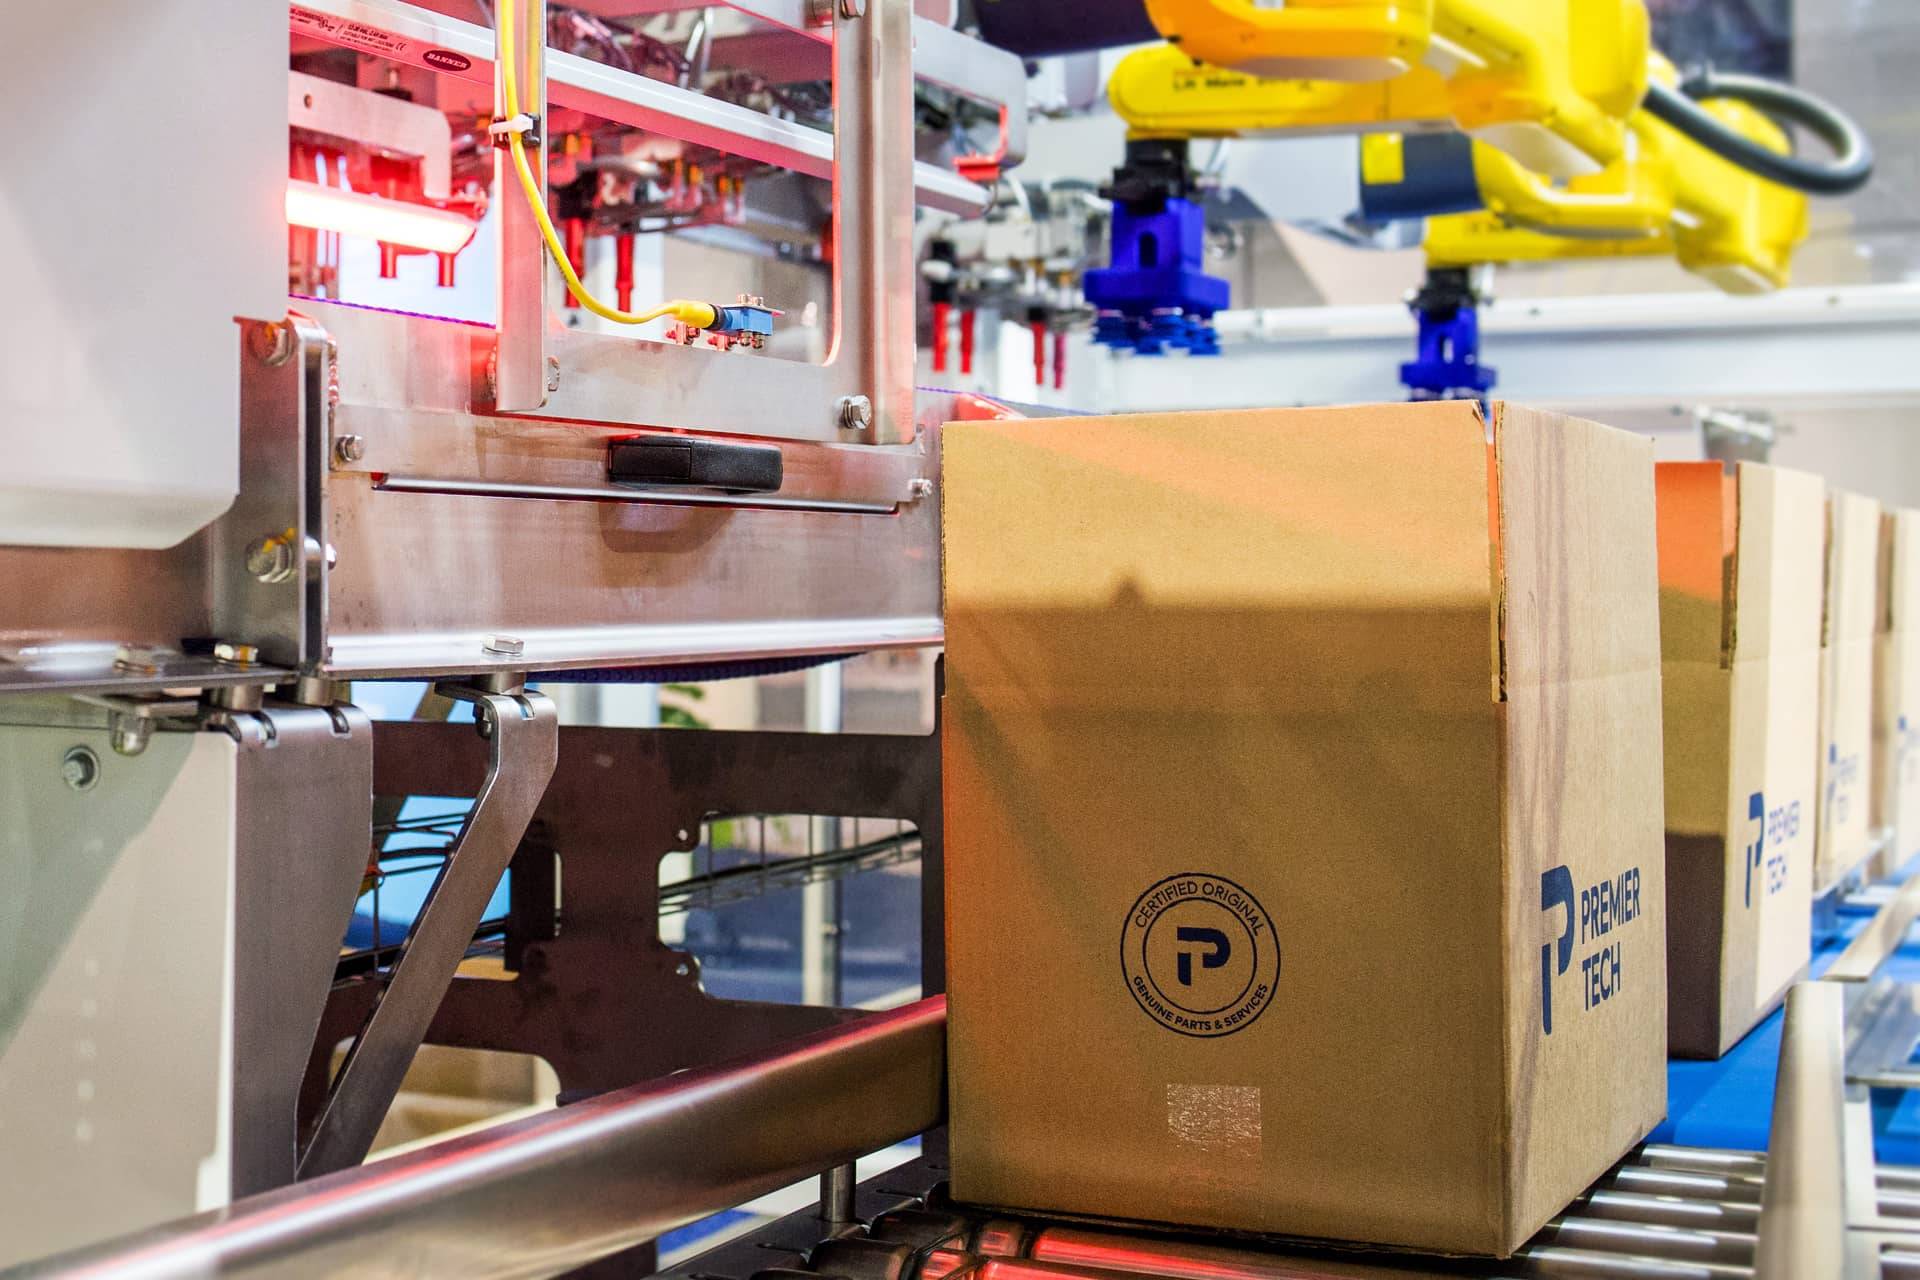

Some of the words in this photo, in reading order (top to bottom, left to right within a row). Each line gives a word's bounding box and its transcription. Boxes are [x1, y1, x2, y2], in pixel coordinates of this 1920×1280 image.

[427, 53, 467, 69] BANNER
[1135, 881, 1198, 928] CERTIFIED
[1202, 882, 1264, 937] ORIGINAL
[1581, 867, 1640, 944] PREMIER
[1134, 976, 1174, 1021] GENUINE
[1175, 1016, 1212, 1031] PARTS
[1214, 1020, 1223, 1030] &
[1224, 983, 1268, 1026] SERVICES
[1582, 941, 1621, 1011] TECH
